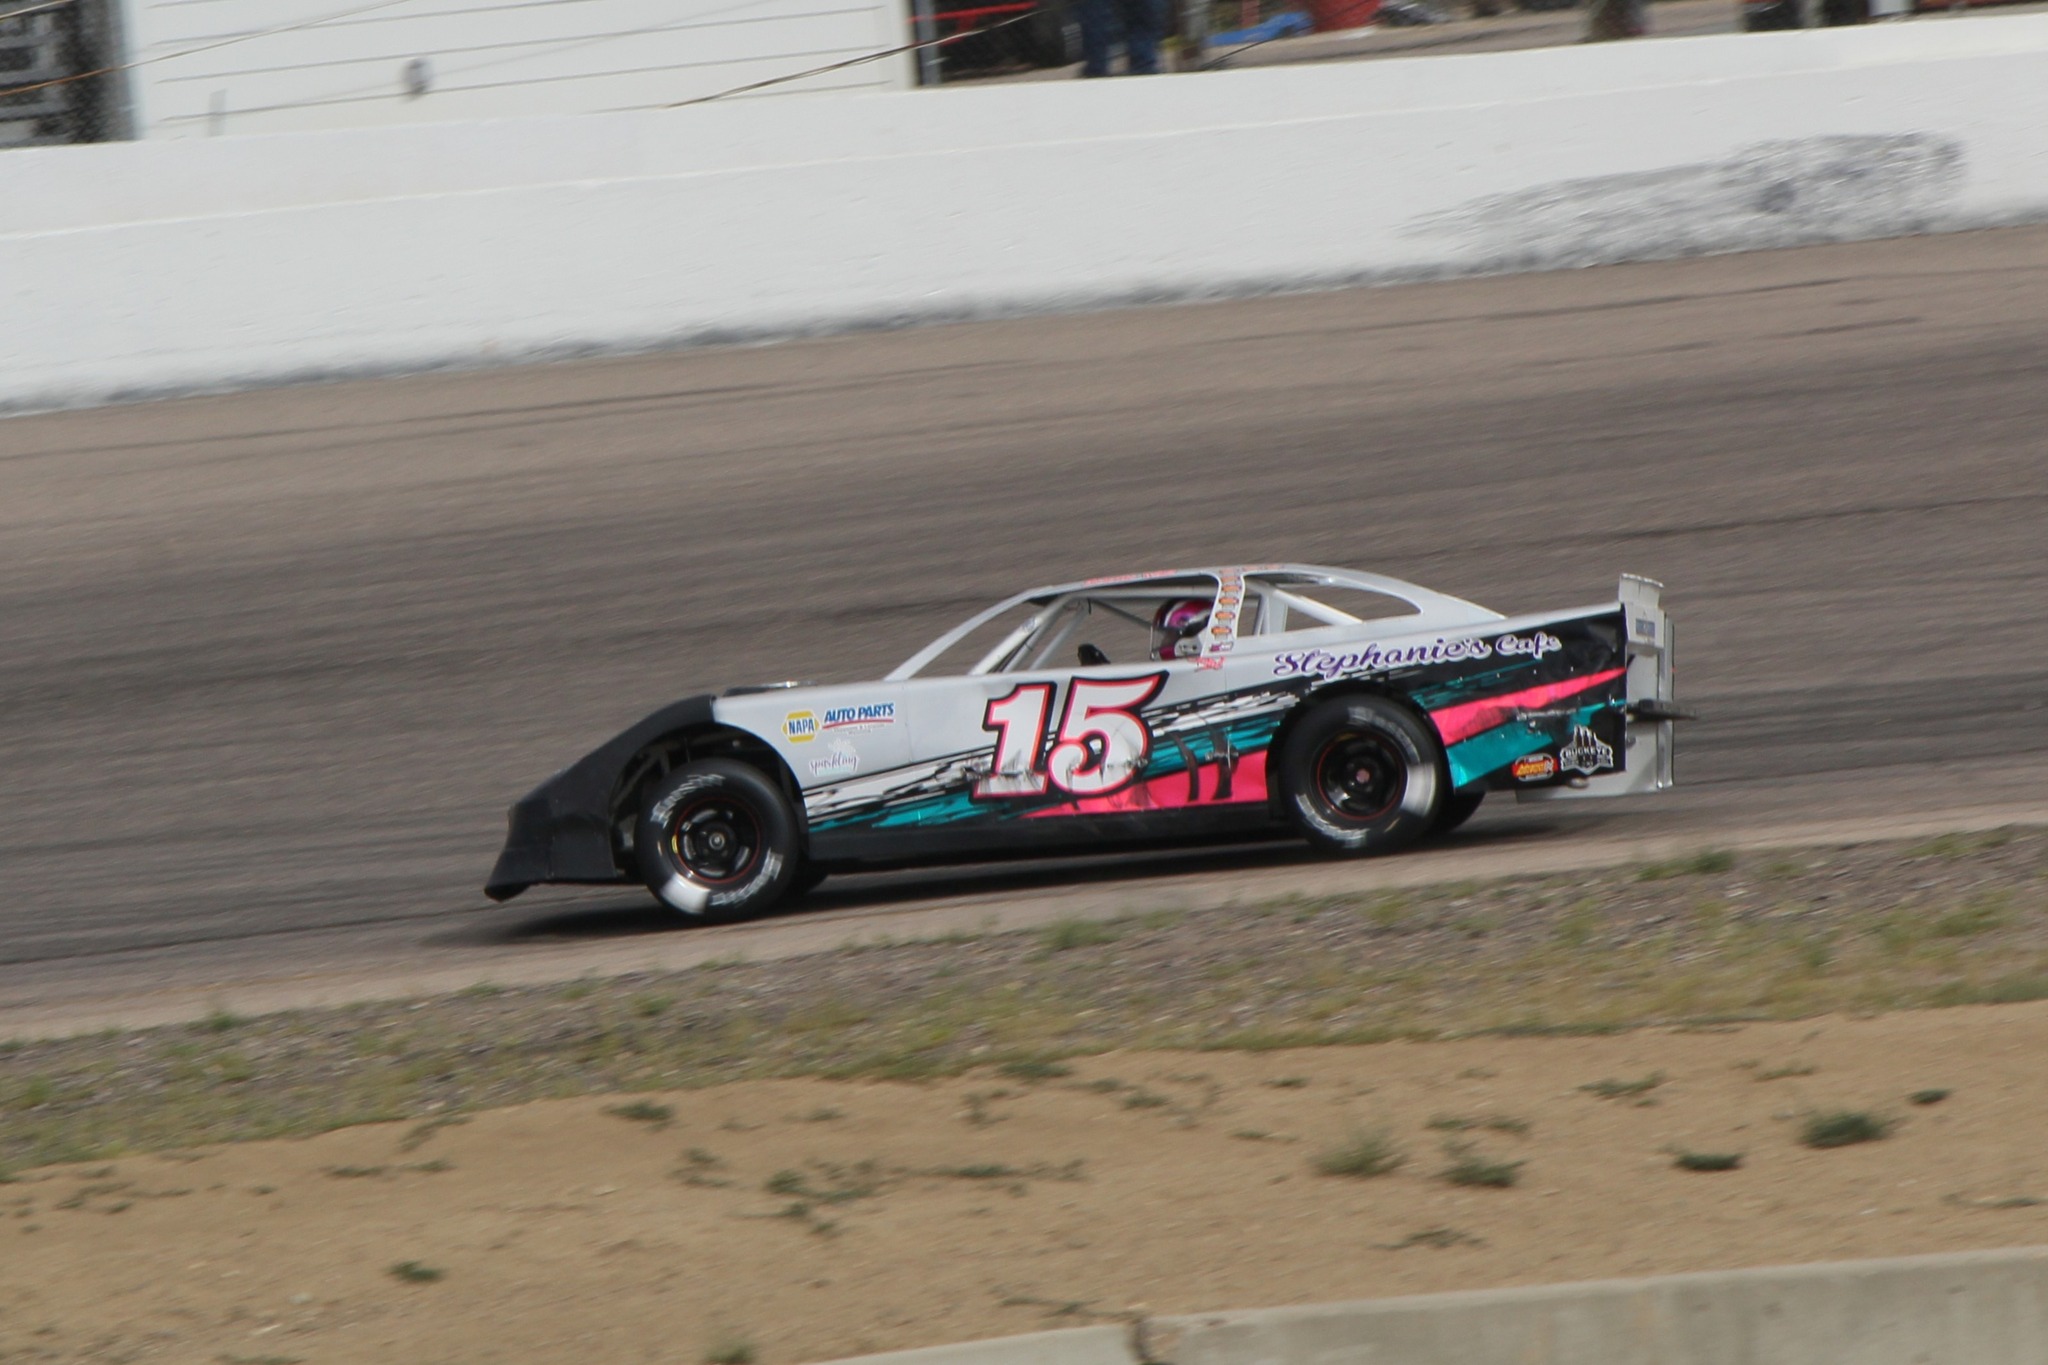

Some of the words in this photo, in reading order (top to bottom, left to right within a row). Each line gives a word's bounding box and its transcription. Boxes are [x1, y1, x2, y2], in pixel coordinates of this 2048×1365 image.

[1273, 639, 1491, 679] Stephanie's
[789, 718, 815, 735] NAPA
[824, 708, 856, 723] AUTO
[857, 702, 894, 719] PARTS
[970, 671, 1169, 801] 15
